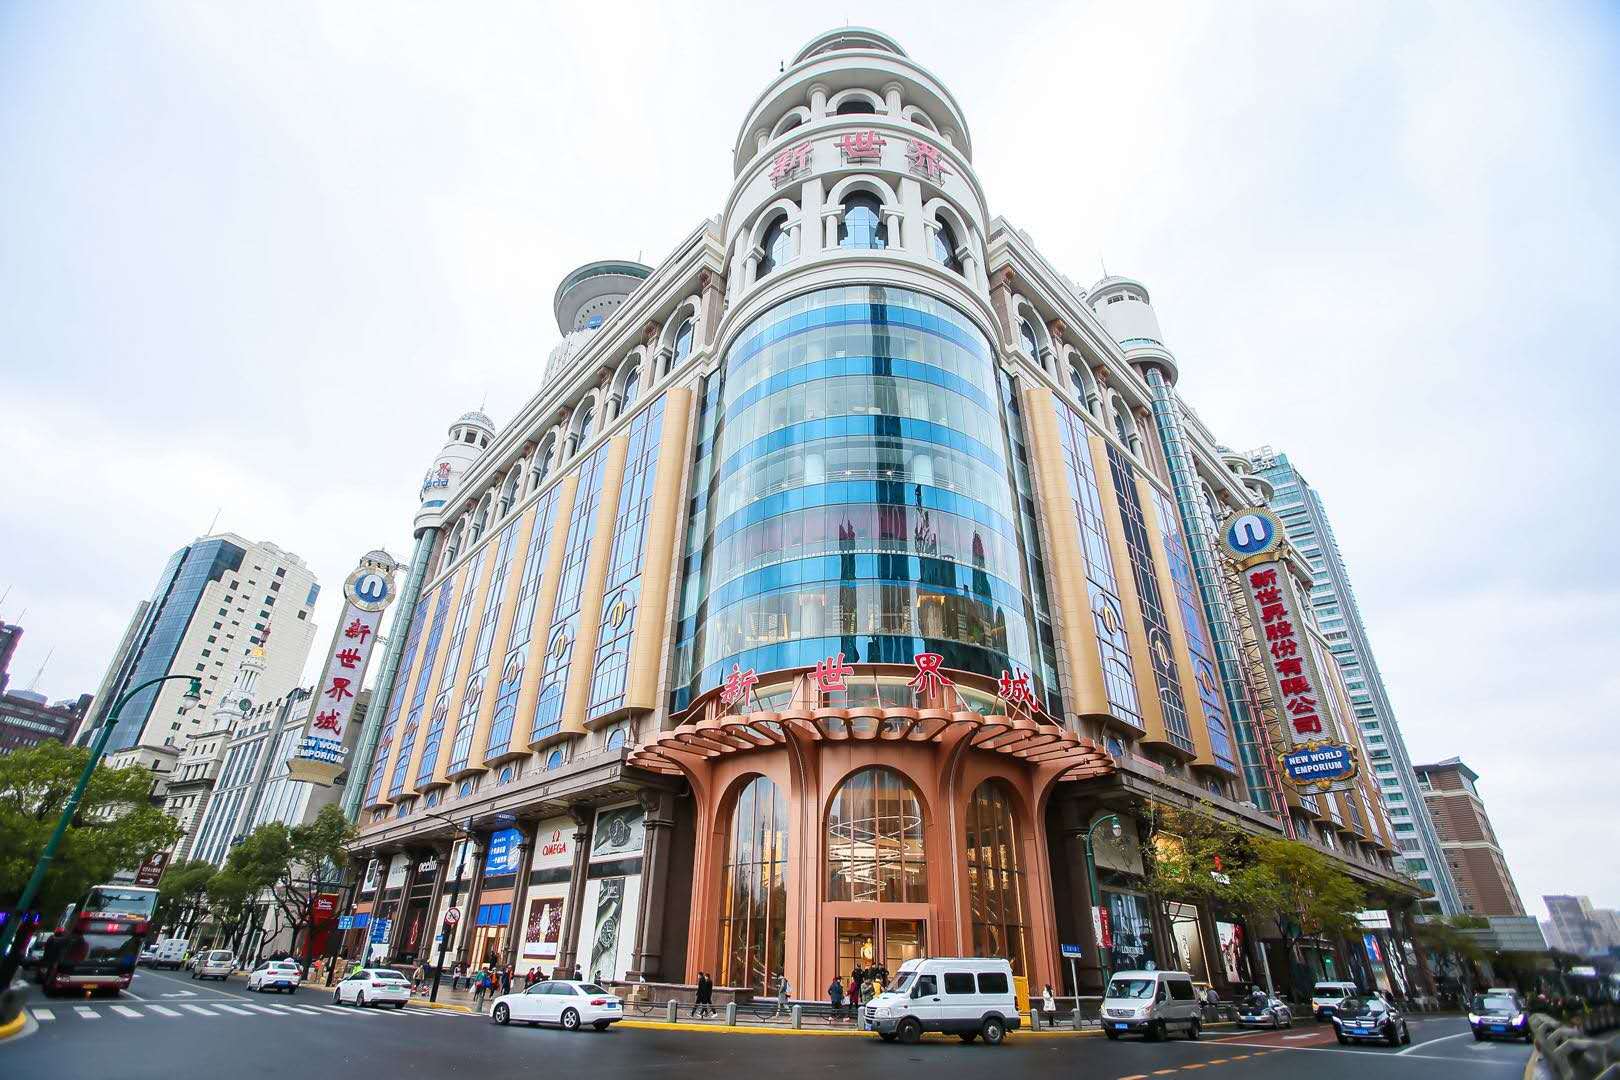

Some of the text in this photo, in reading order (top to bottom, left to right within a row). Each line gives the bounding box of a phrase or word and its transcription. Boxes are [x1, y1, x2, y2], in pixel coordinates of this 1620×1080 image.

[768, 130, 953, 184] 新世界
[1249, 568, 1322, 735] 新世界股份有限公司
[313, 618, 371, 736] 新世界城
[720, 652, 1039, 713] 新世界城
[319, 740, 349, 754] WORLD
[294, 748, 345, 763] EMPORIUM
[1289, 750, 1342, 765] NEW WORLD
[1295, 760, 1343, 775] EMPORIUM
[542, 842, 567, 857] OMEGA
